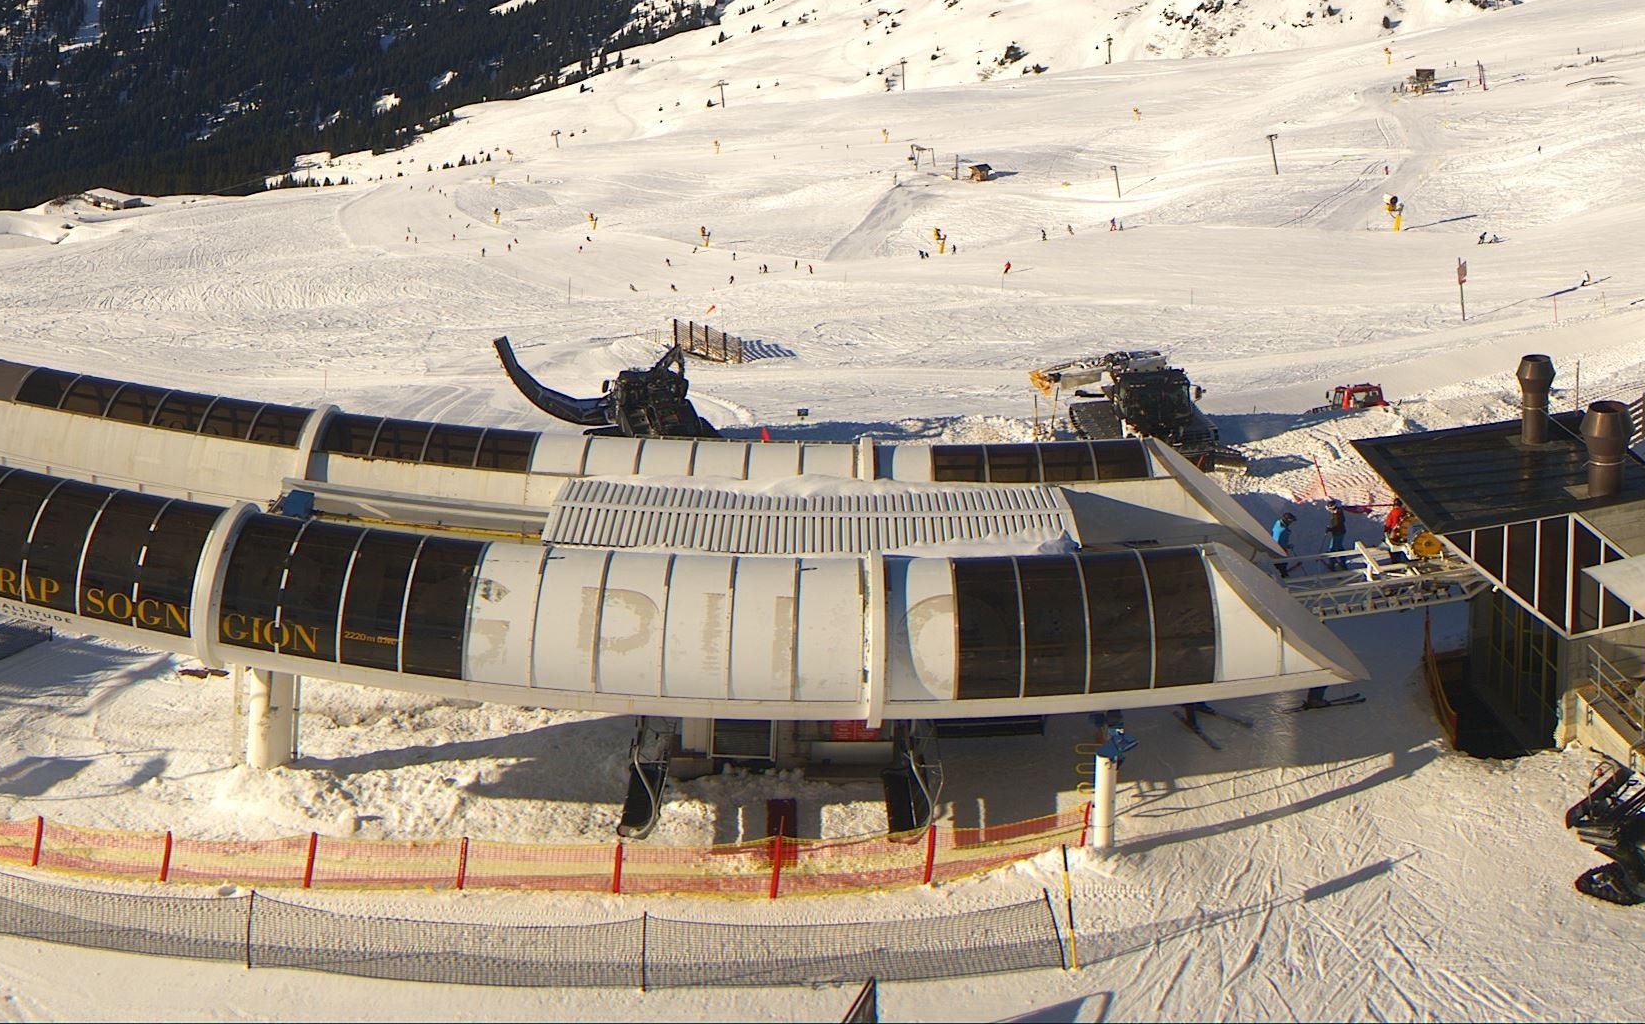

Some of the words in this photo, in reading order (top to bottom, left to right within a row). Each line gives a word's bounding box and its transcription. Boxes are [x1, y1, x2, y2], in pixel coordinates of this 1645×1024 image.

[2, 602, 73, 624] ALTITUDE
[86, 588, 189, 632] SOGN
[222, 613, 319, 653] GION
